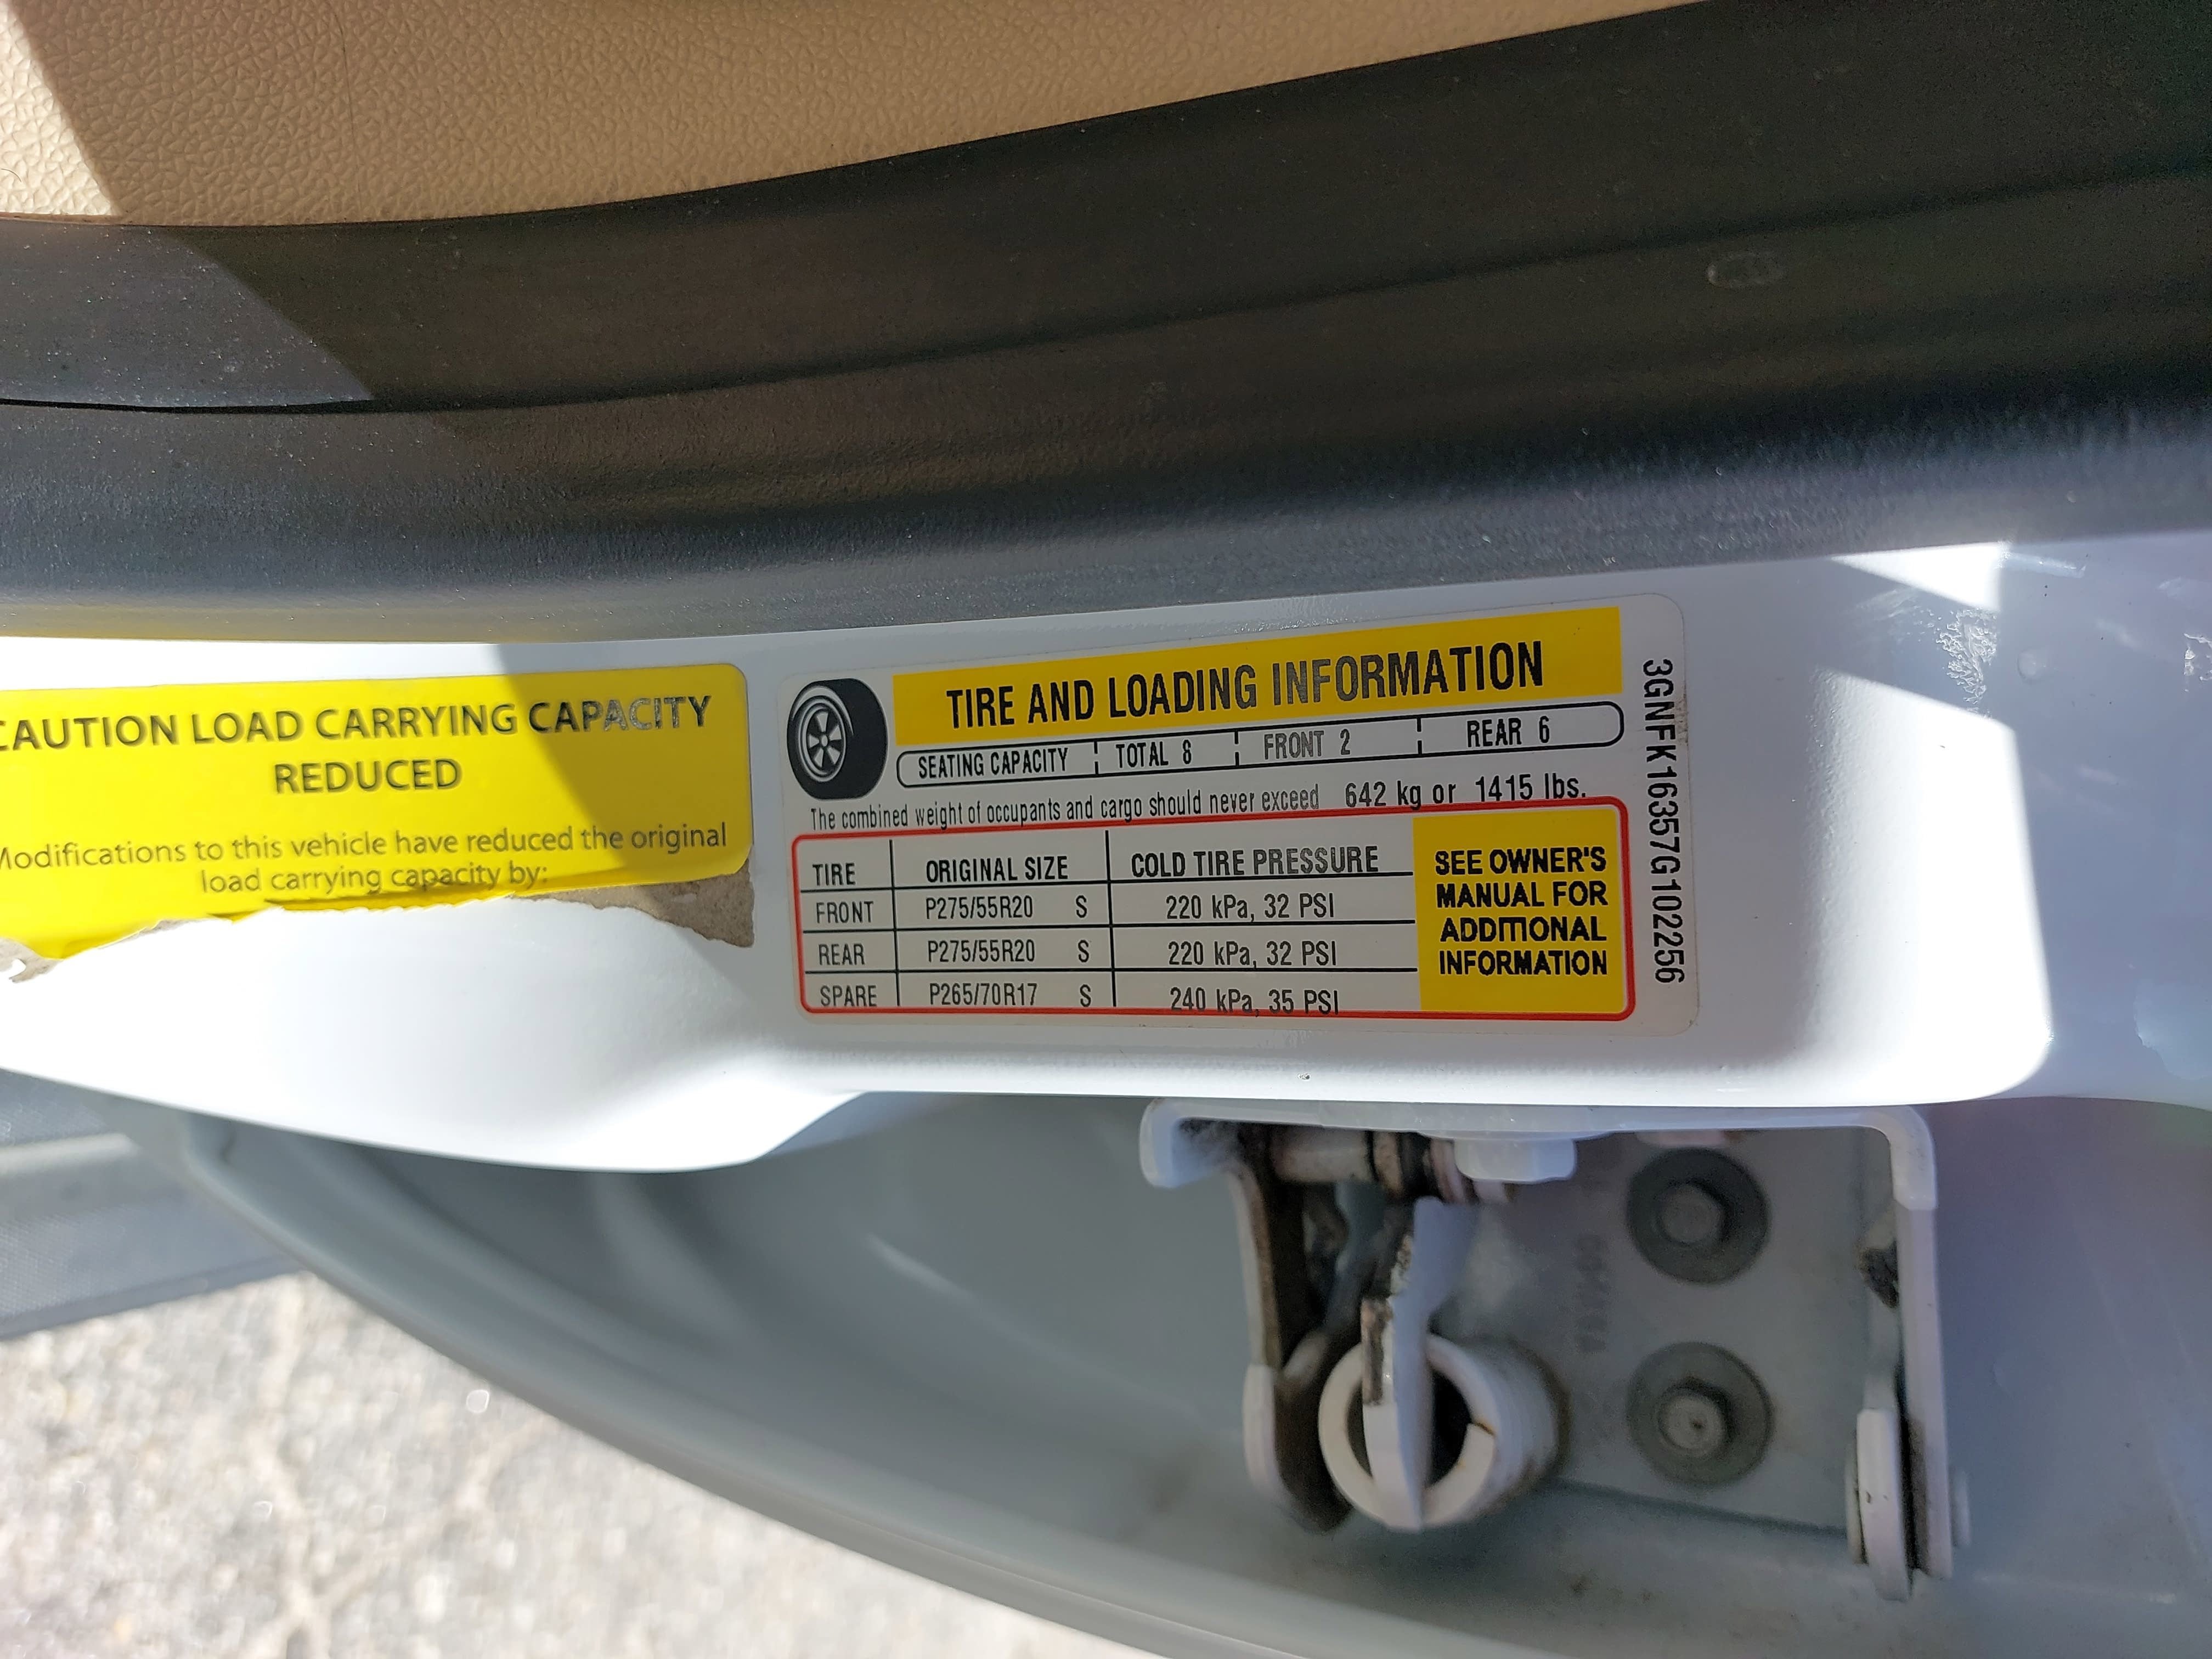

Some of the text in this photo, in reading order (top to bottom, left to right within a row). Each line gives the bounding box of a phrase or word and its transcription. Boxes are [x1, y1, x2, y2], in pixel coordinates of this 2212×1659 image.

[946, 640, 1543, 730] TIRE AND LOADING INFORMATION
[192, 709, 300, 744] LOAD
[315, 703, 517, 741] CARRYING
[528, 695, 712, 731] CAPACITY
[1466, 716, 1550, 748] REAR 6
[1115, 739, 1193, 768] TOTAL 8
[1263, 729, 1351, 760] FRONT 2
[274, 758, 462, 794] REDUCED
[918, 748, 1069, 779] SEATING CAPACITY
[810, 772, 1587, 831] The combined weight of occupants and cargo should never exceed 642 kg or 1415 lbs.
[1643, 658, 1684, 983] 3GNFK16357G102256
[194, 842, 223, 860] to
[233, 836, 281, 859] this
[291, 832, 387, 857] vehicle
[396, 830, 458, 853] have
[467, 826, 573, 853] reduced
[581, 826, 623, 849] the
[631, 822, 726, 854] original
[812, 862, 856, 887] TIRE
[926, 855, 1069, 883] ORIGINAL SIZE
[1131, 845, 1379, 878] COLD TIRE PRESSURE
[1435, 845, 1607, 876] SEE OWNER'S
[201, 861, 548, 895] load carrying capacity by:
[926, 895, 1088, 920] P275/55R20 S
[1165, 893, 1335, 923] 220 kPa, 32 PSI
[1437, 881, 1608, 909] MANUAL FOR
[815, 900, 874, 925] FRONT
[1440, 916, 1607, 943] ADDITIONAL
[819, 943, 865, 966] REAR
[927, 939, 1090, 963] P275/55R20 S
[1168, 940, 1337, 969] 220 kPa, 32 PSI
[1439, 950, 1607, 975] INFORMATION
[820, 984, 877, 1007] SPARE
[929, 983, 1092, 1007] P265/70R17 S
[1170, 986, 1339, 1018] 240 kPa, 35 PSI
